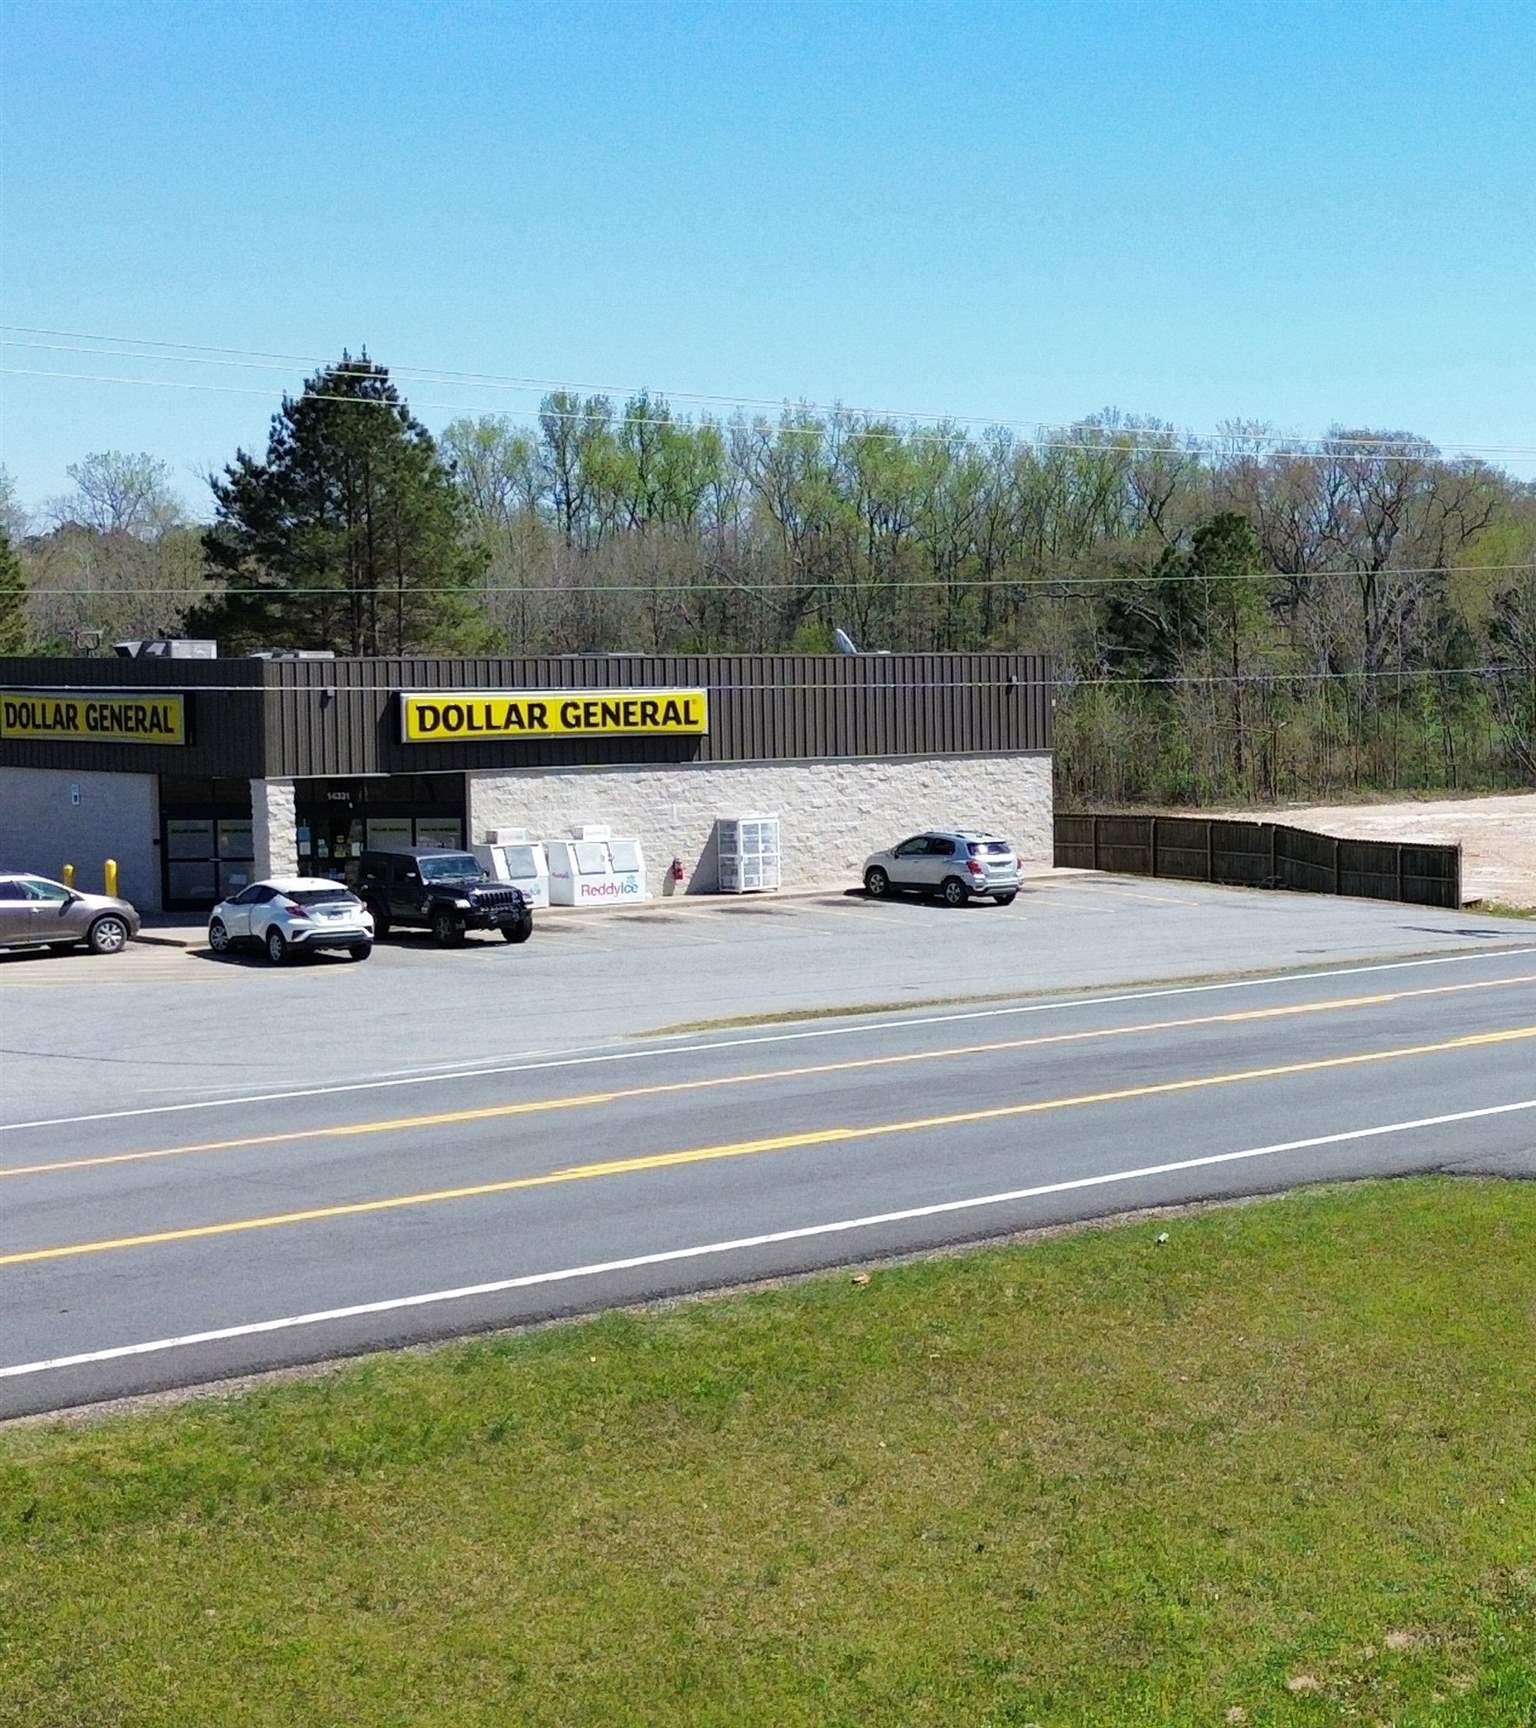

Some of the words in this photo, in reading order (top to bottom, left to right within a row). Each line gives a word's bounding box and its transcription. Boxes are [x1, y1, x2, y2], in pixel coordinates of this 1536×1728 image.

[4, 702, 79, 731] DOLLAR
[85, 703, 175, 734] GENERAL
[416, 702, 549, 732] DOLLAR
[560, 699, 699, 729] GENERAL
